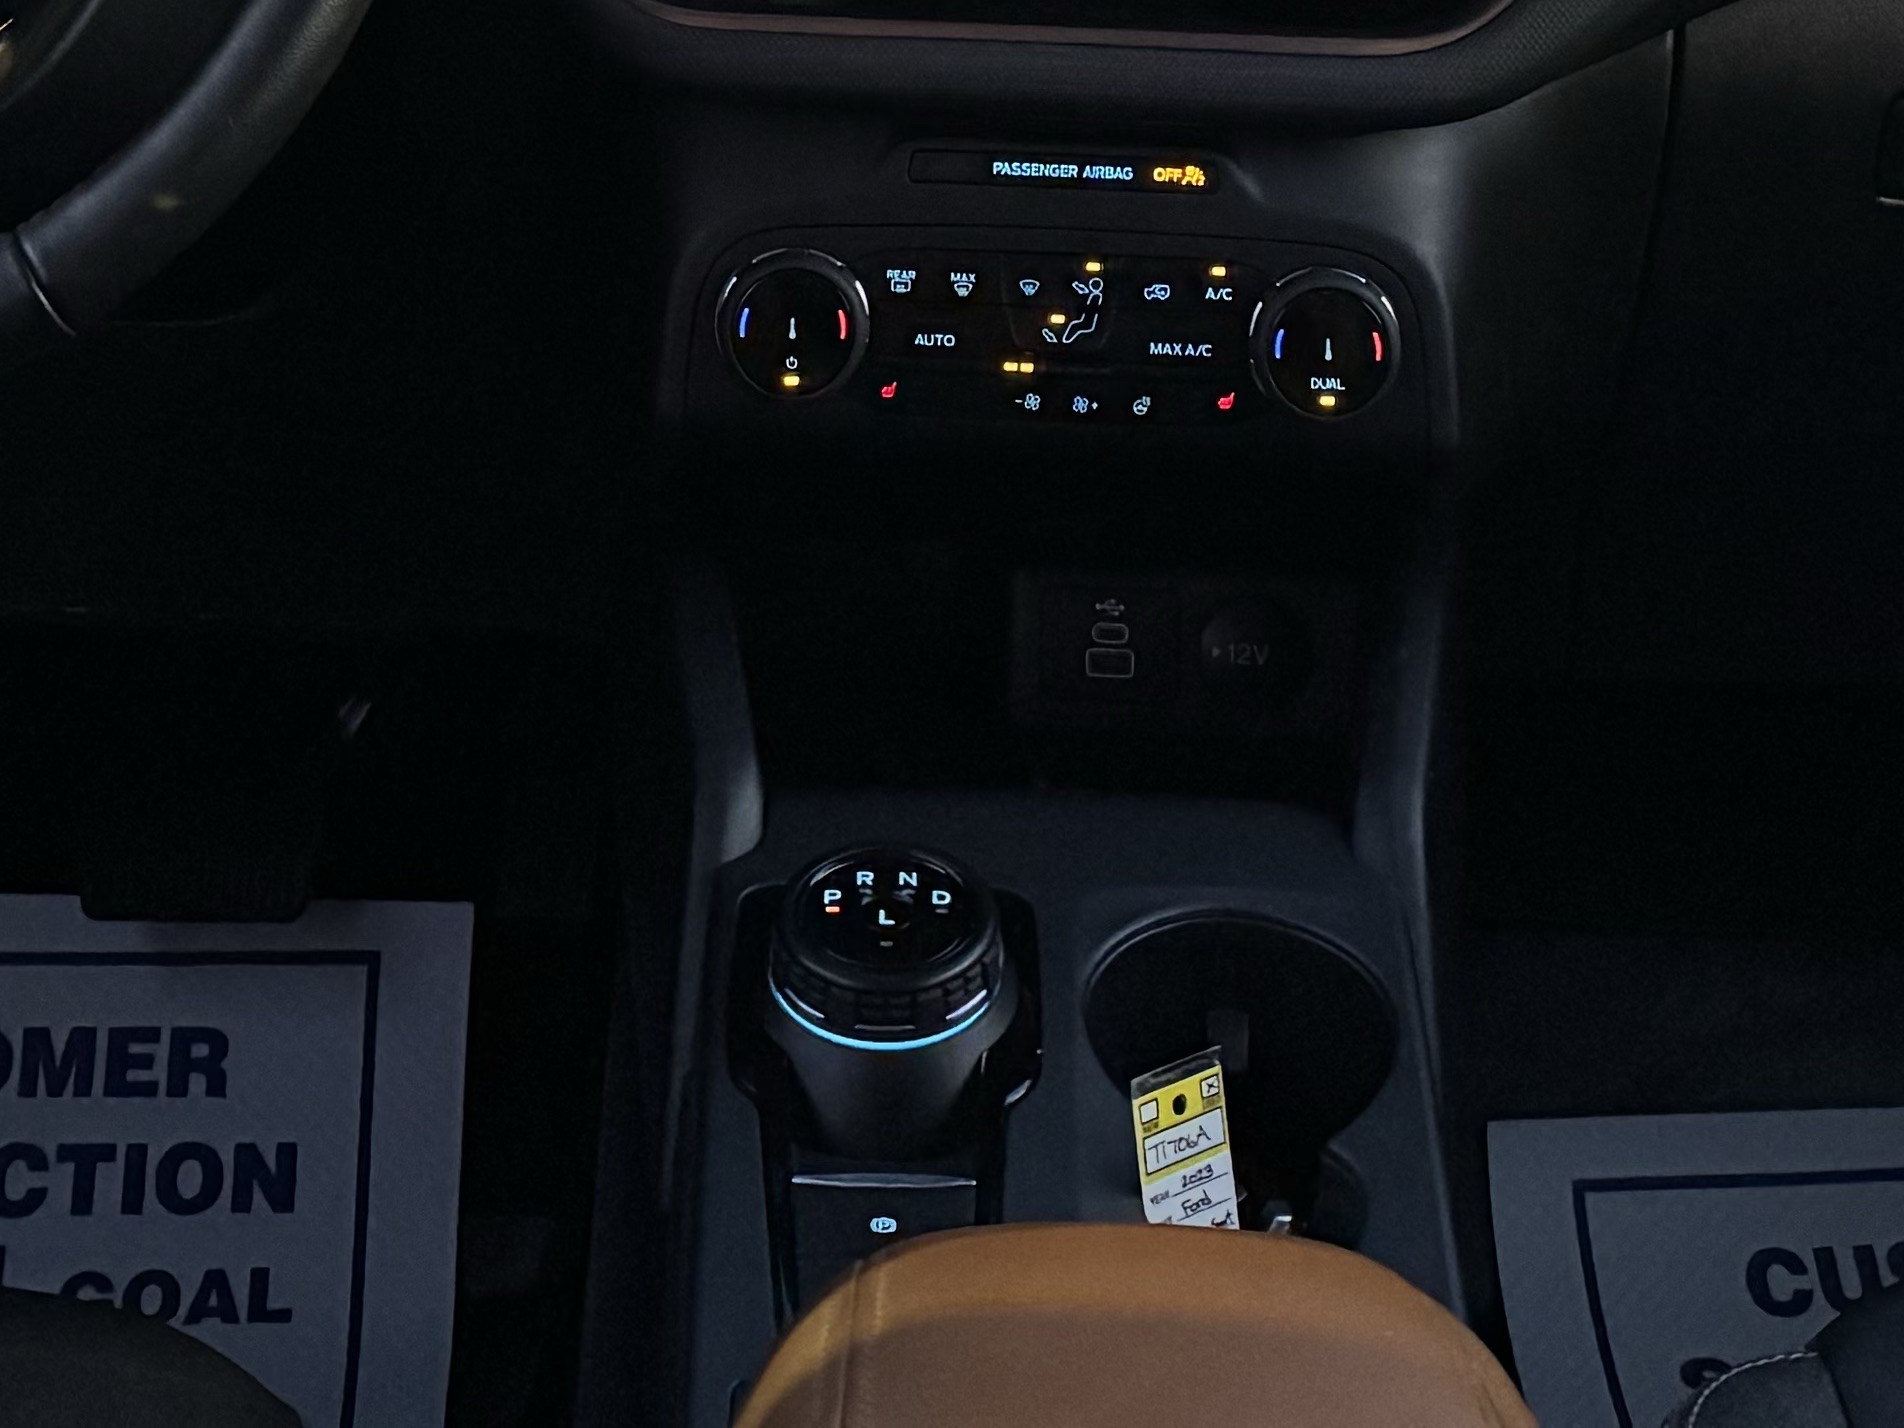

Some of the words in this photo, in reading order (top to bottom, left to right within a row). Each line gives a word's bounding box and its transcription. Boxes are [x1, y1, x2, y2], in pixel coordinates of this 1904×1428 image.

[993, 162, 1078, 179] PASSENGER
[1082, 165, 1134, 181] AIRBAG
[1152, 167, 1183, 183] OFF
[886, 270, 916, 281] REAR
[950, 273, 976, 283] MAX
[1205, 287, 1232, 302] A/C
[915, 333, 956, 347] AUTO
[1149, 343, 1183, 357] MAX
[1184, 345, 1212, 358] A/C
[1310, 377, 1346, 391] DUAL
[1226, 643, 1270, 666] 12V
[857, 871, 875, 886] R
[898, 871, 918, 886] N
[823, 889, 842, 906] P
[932, 889, 952, 906] D
[878, 910, 896, 926] L
[60, 1267, 293, 1325] GOAL
